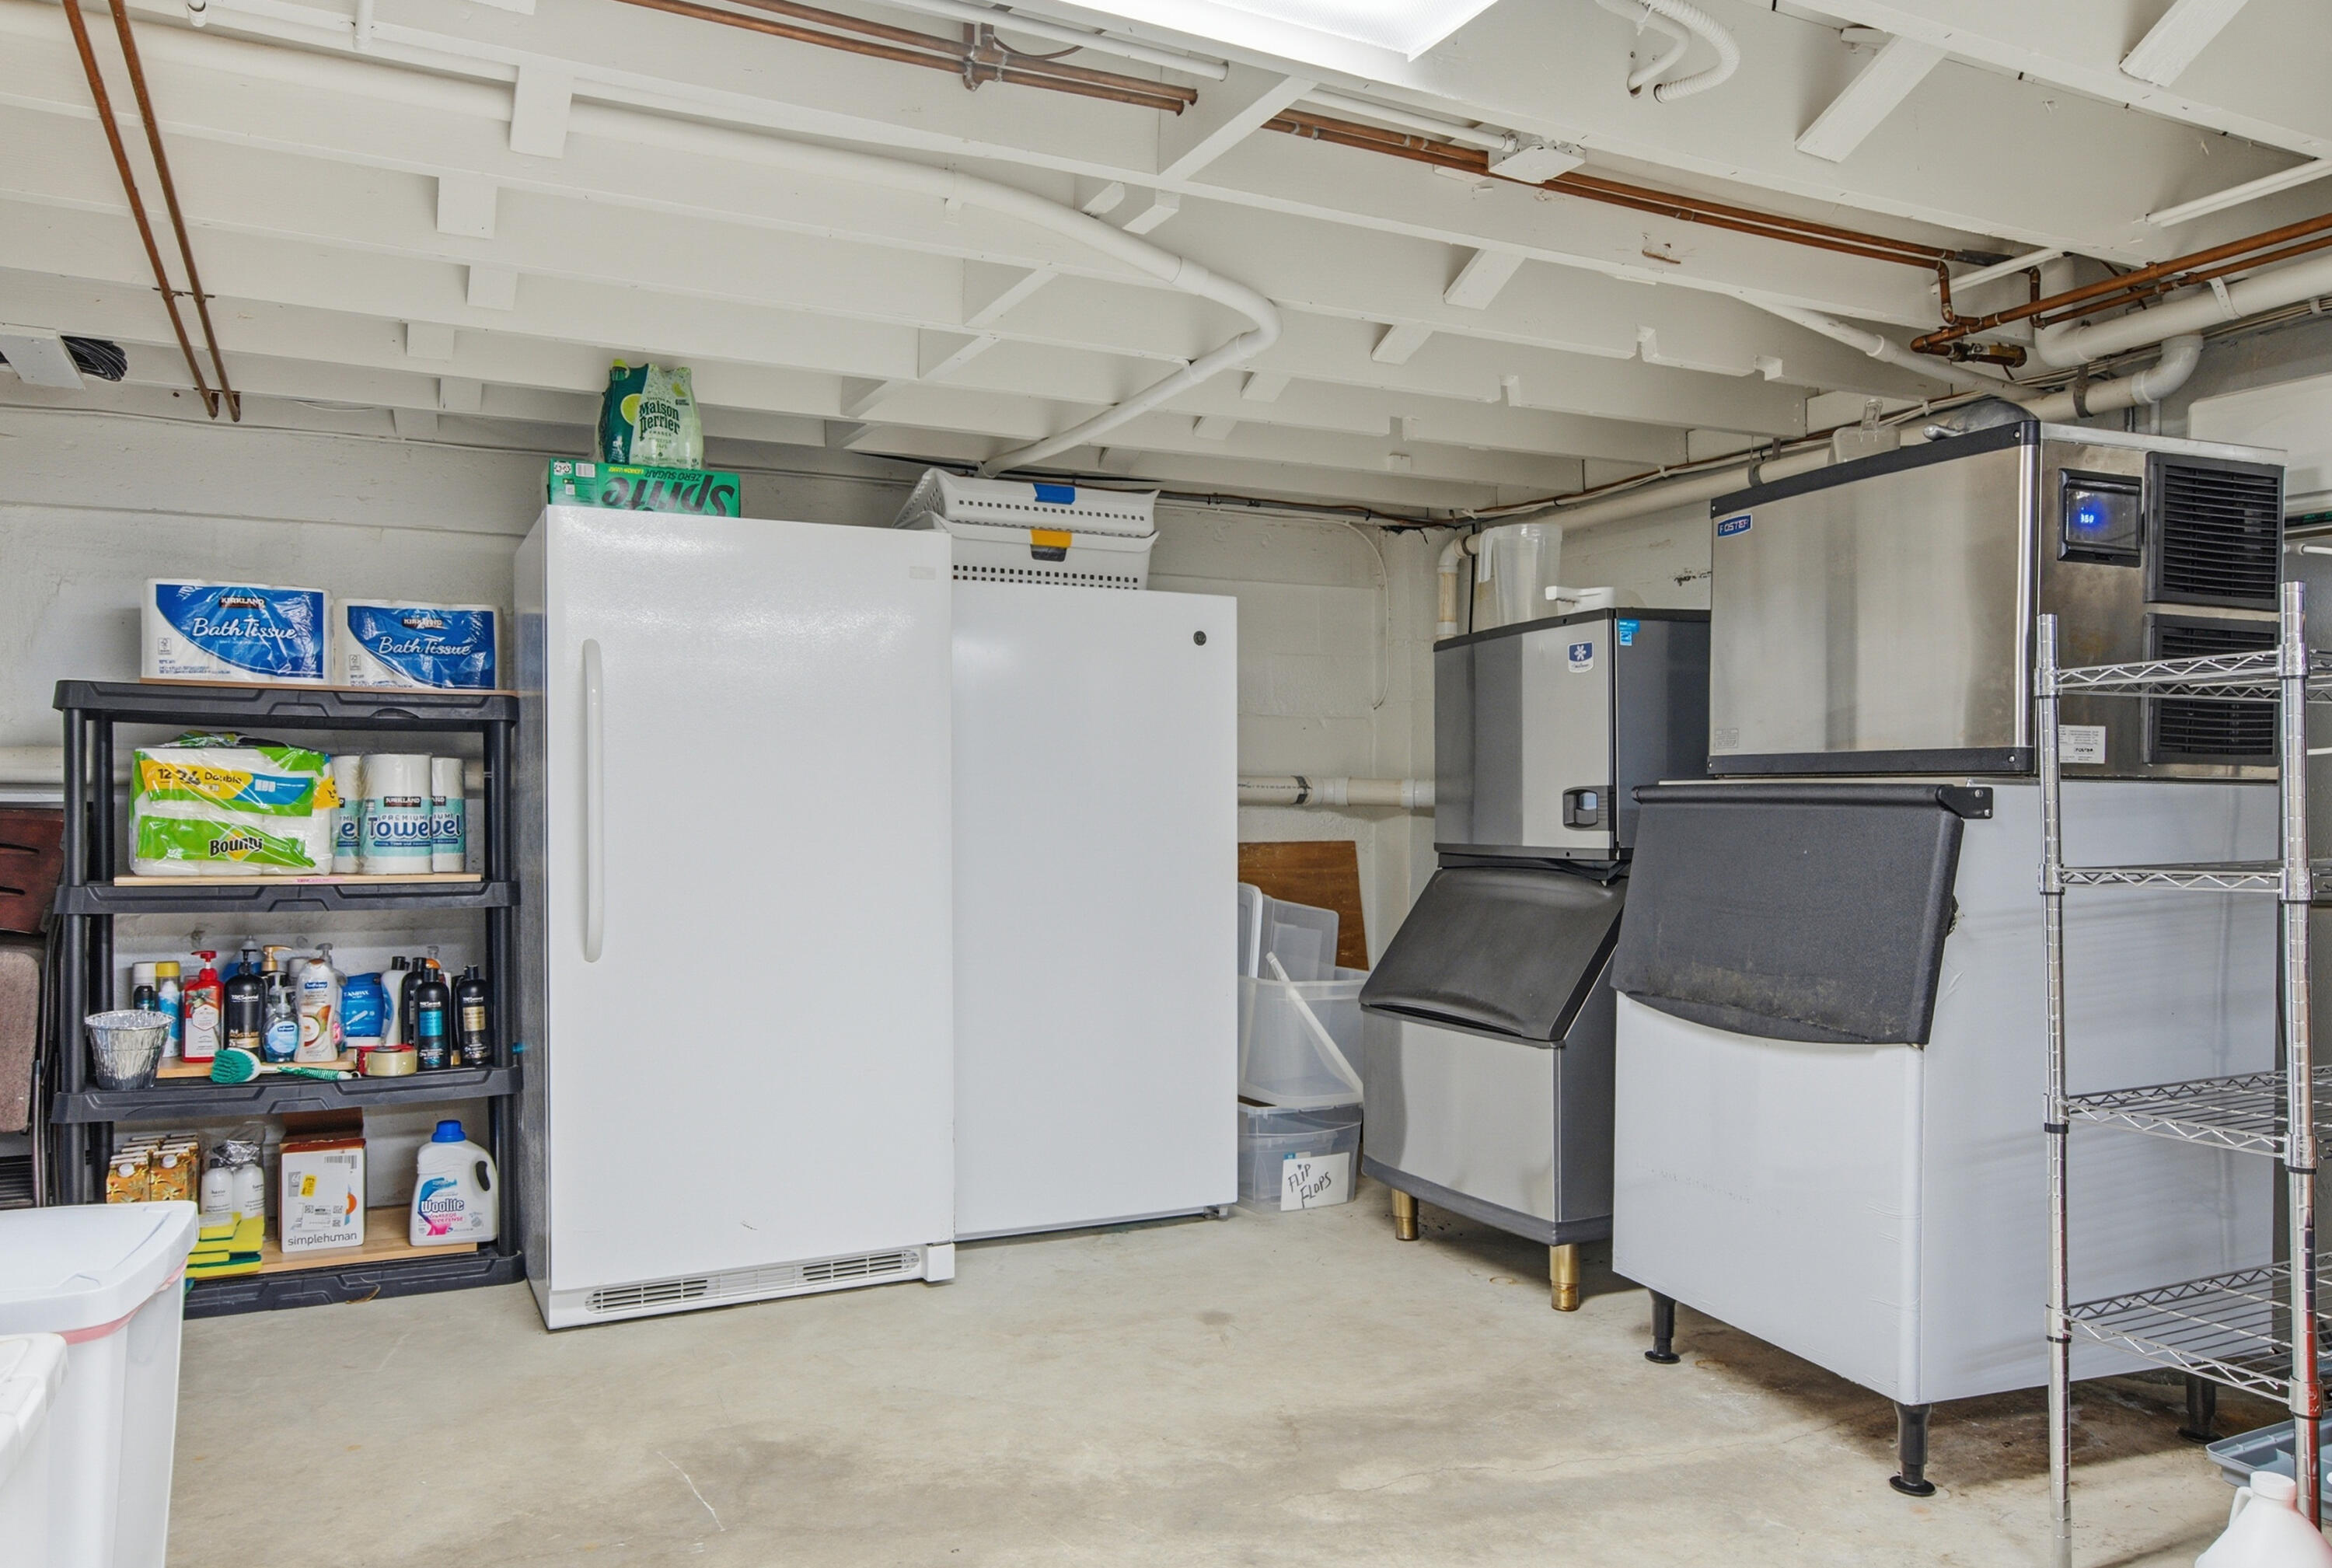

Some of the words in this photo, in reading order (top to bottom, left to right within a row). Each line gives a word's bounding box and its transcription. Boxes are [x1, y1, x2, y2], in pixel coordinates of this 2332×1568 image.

[639, 400, 679, 421] Maison
[644, 470, 678, 480] SUGAR
[679, 473, 703, 482] ZERO
[221, 597, 265, 606] KIRKLAND
[193, 617, 243, 637] Bath
[243, 615, 297, 639] Tissue
[379, 637, 424, 654] Bath
[422, 637, 471, 655] Tissue
[158, 769, 172, 779] 12
[204, 773, 243, 784] Double
[209, 837, 263, 857] Bounty
[1300, 1171, 1332, 1210] FLOPS
[421, 1199, 464, 1213] Woolite
[288, 1232, 357, 1246] simplehuman
